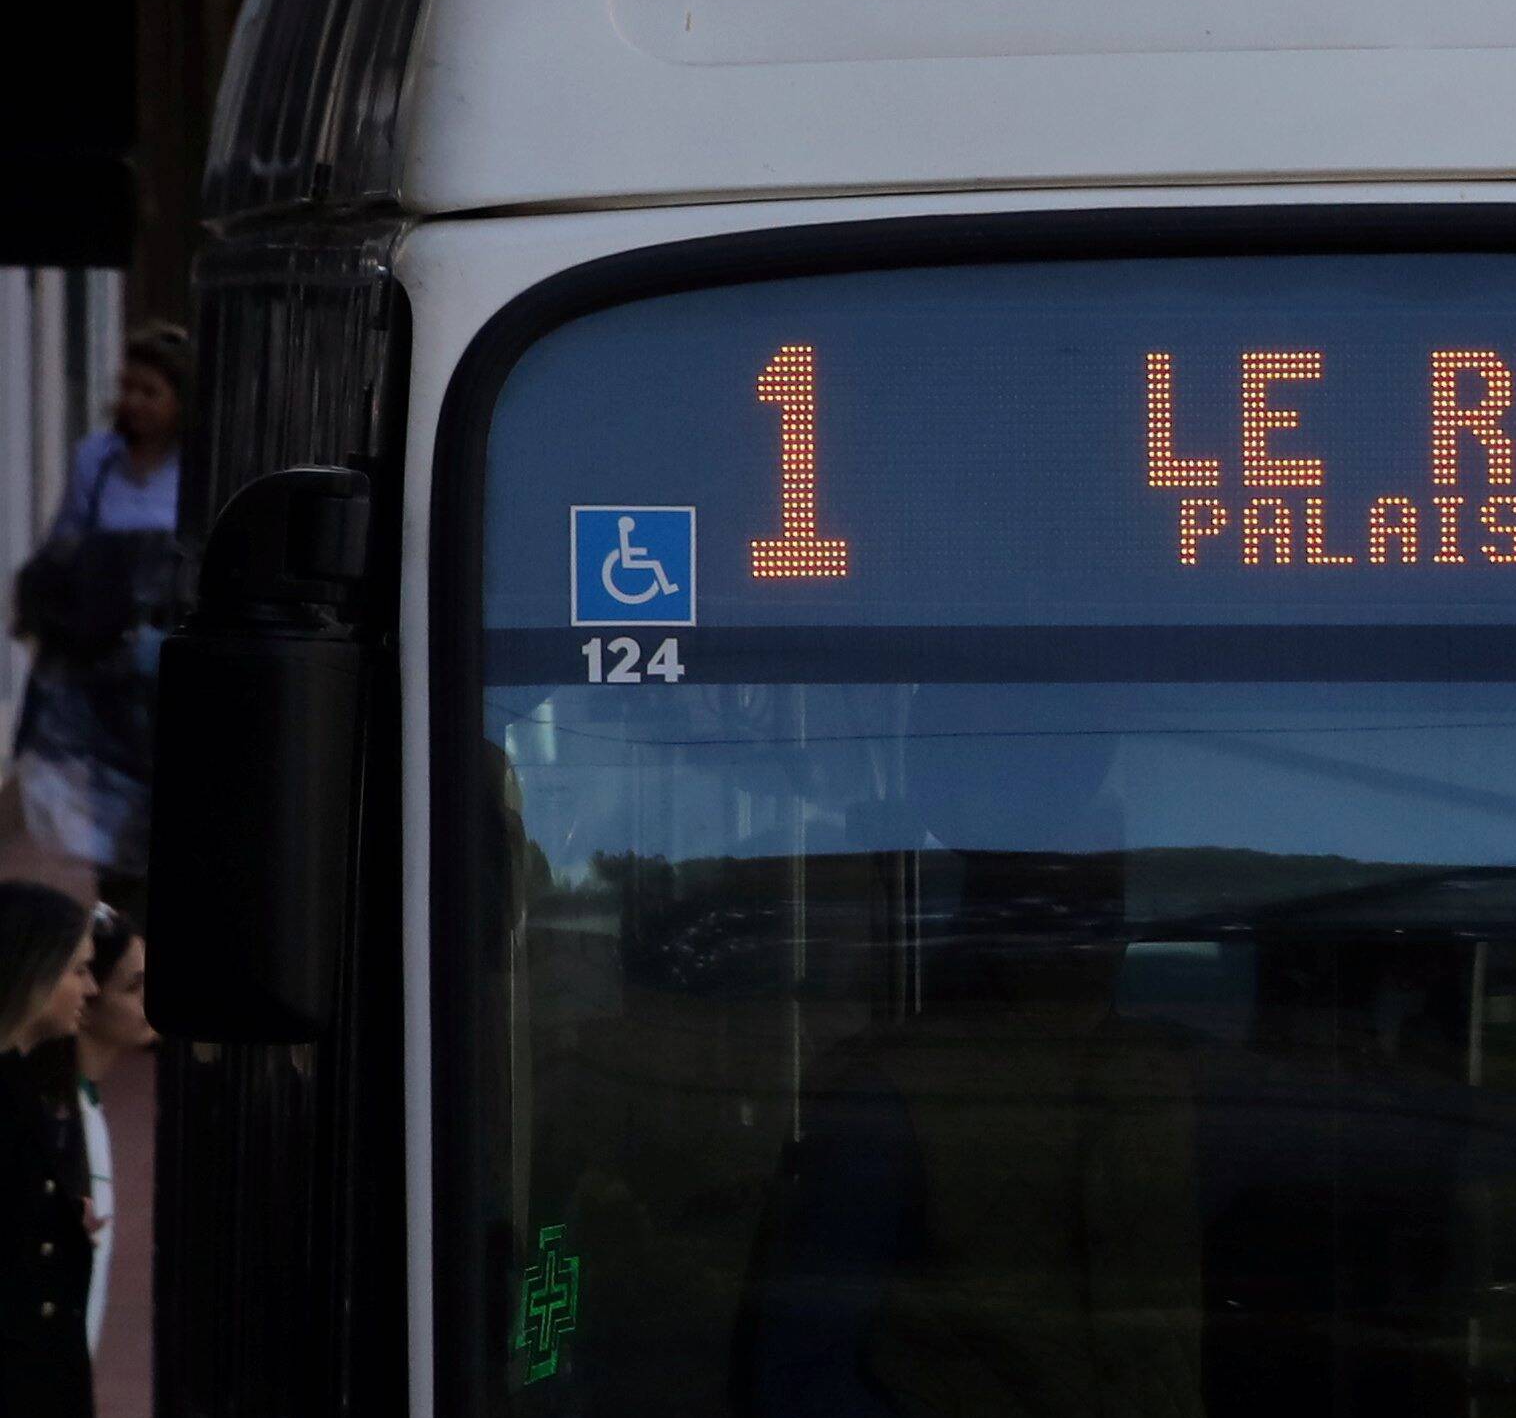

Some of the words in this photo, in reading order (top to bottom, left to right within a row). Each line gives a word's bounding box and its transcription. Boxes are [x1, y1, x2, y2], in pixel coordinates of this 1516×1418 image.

[750, 344, 849, 578] 1
[1145, 350, 1322, 488] LE
[581, 638, 685, 684] 124
